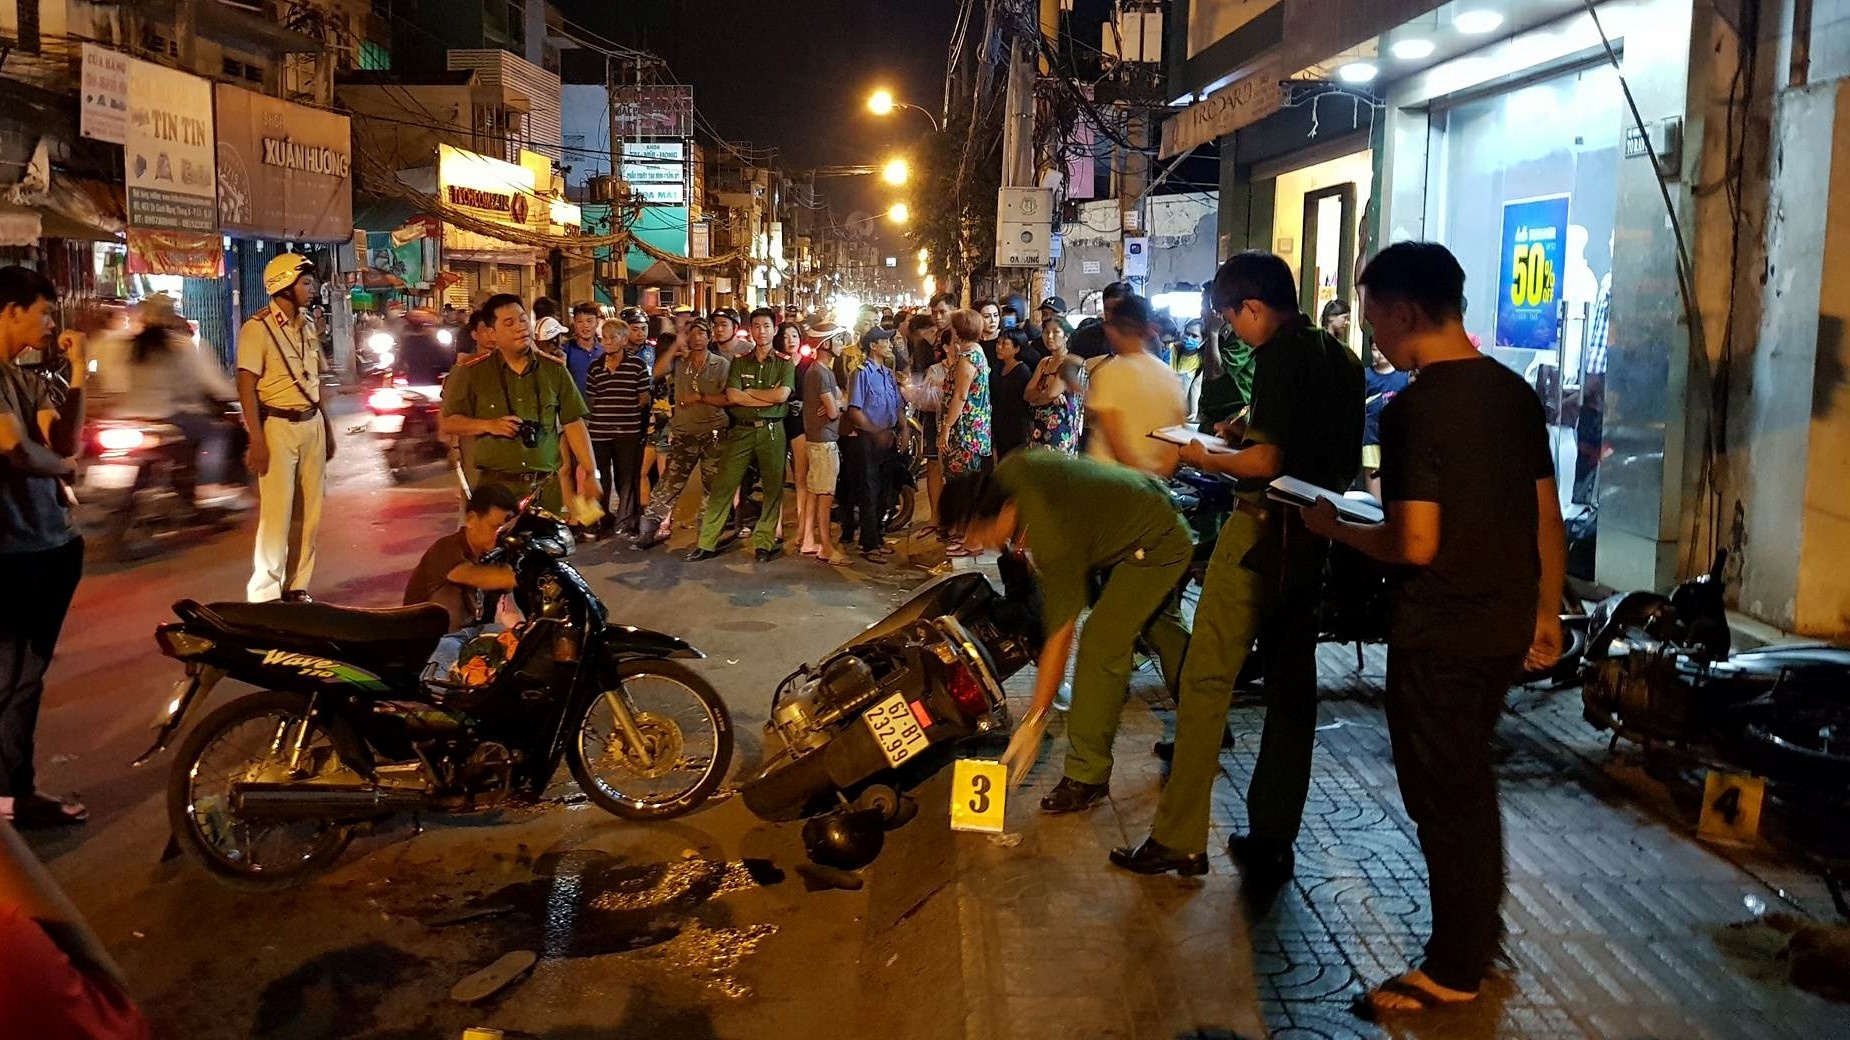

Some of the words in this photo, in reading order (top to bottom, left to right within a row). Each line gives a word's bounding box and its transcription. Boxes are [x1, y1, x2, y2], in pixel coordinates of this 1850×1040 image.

[152, 109, 178, 143] TIN
[181, 115, 206, 147] TIN
[1511, 242, 1555, 306] 50%
[262, 649, 341, 669] Wave
[867, 706, 909, 763] 232.99
[968, 774, 991, 814] 3
[1711, 784, 1742, 825] 4
